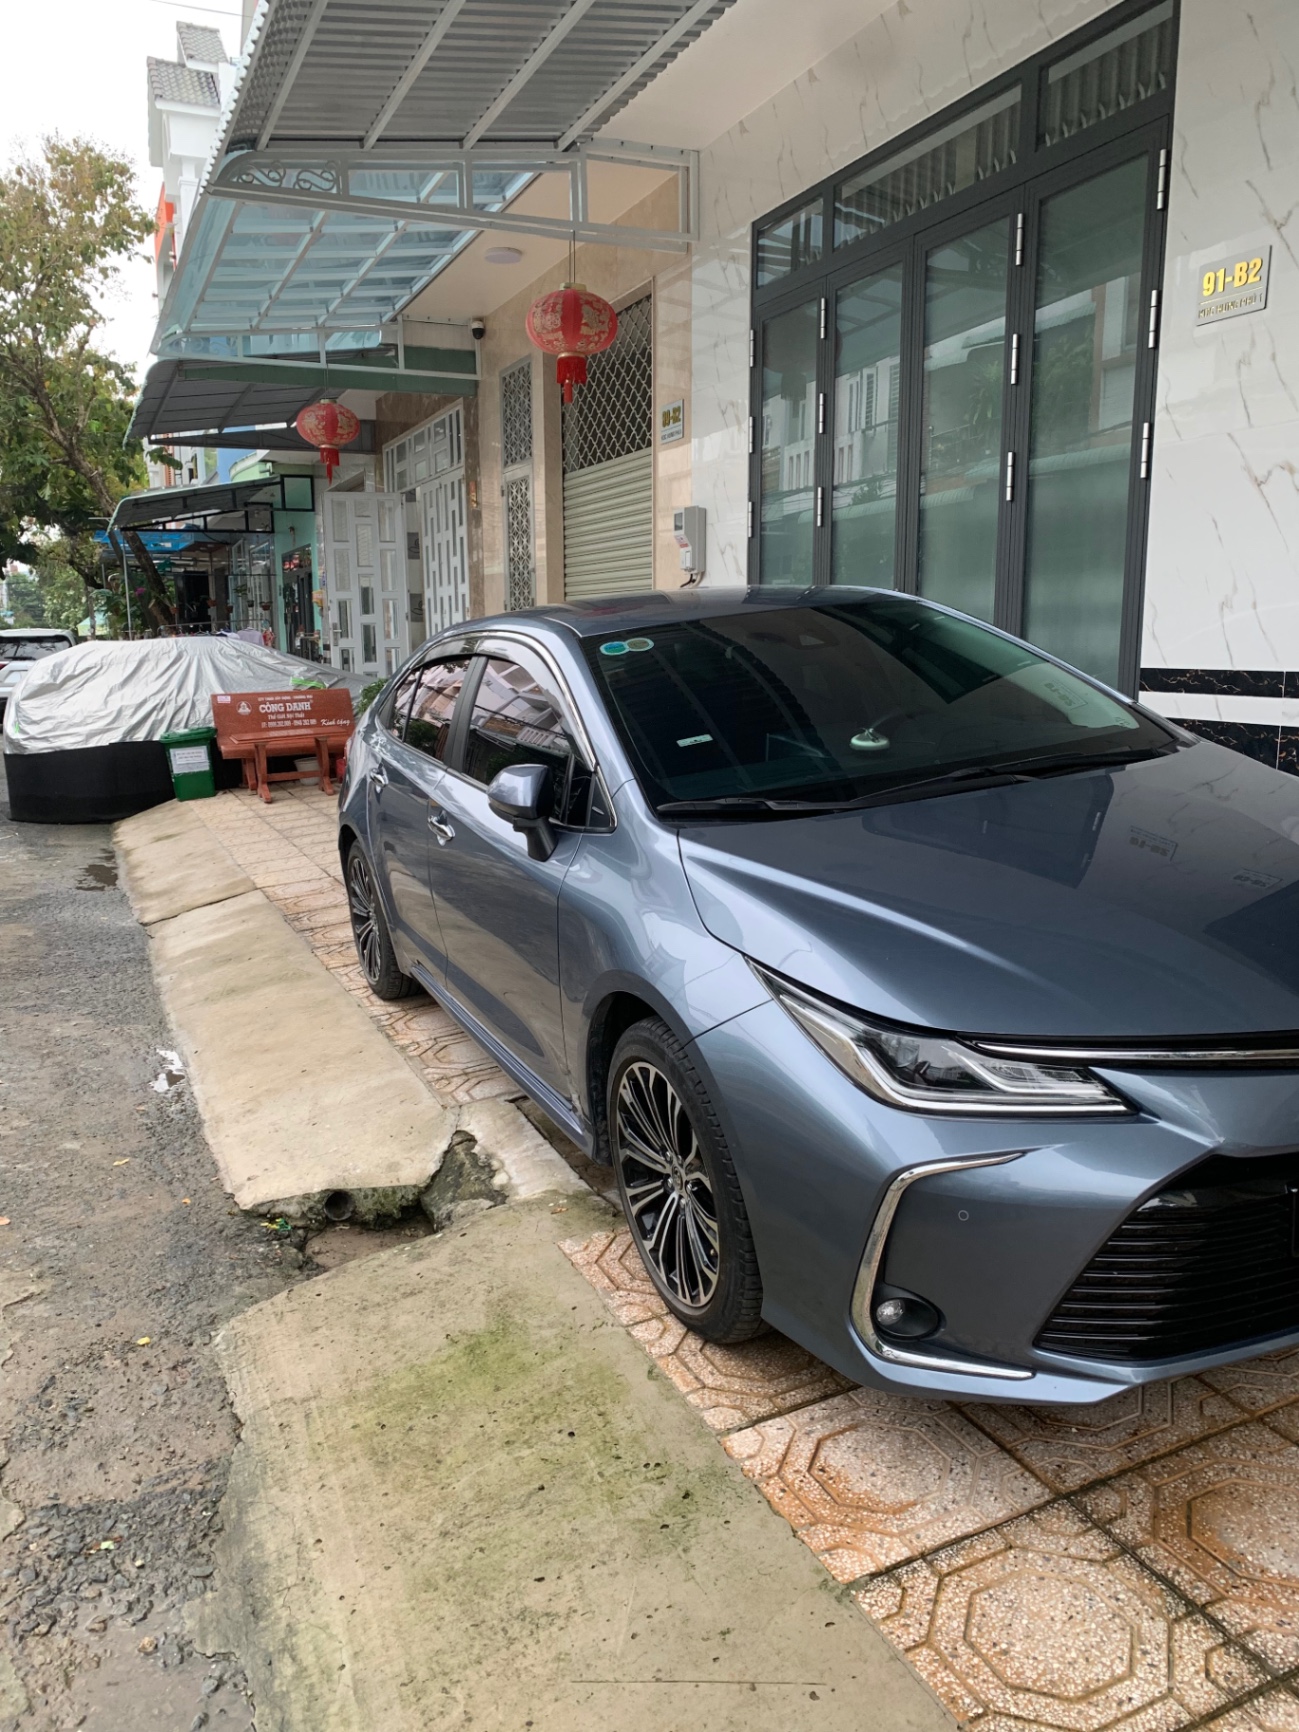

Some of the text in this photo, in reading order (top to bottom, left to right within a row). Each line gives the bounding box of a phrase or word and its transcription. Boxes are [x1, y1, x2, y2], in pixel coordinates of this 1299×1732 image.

[1202, 257, 1263, 297] 91-B2
[259, 701, 311, 714] CÔNG DANH
